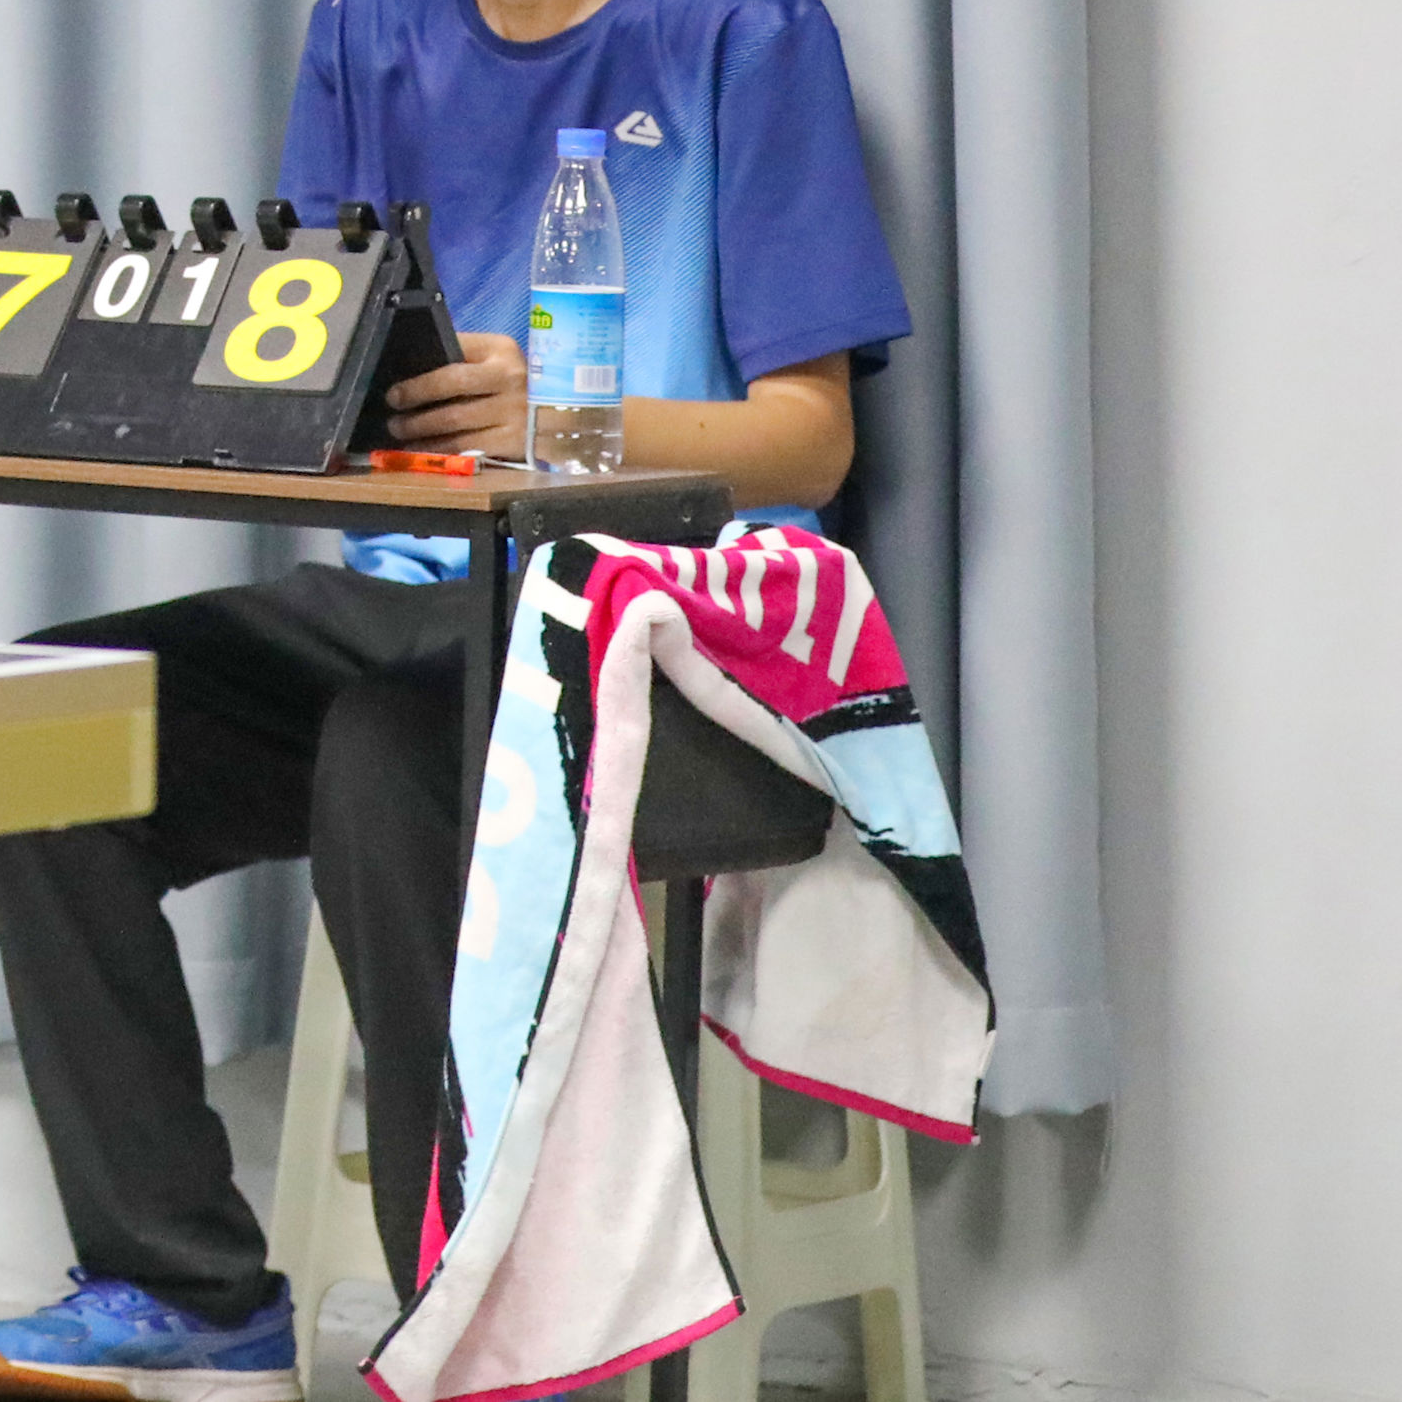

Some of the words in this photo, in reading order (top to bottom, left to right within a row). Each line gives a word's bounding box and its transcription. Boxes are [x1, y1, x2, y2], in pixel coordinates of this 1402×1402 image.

[93, 254, 151, 319] 0
[180, 256, 219, 320] 1
[224, 258, 342, 382] 8
